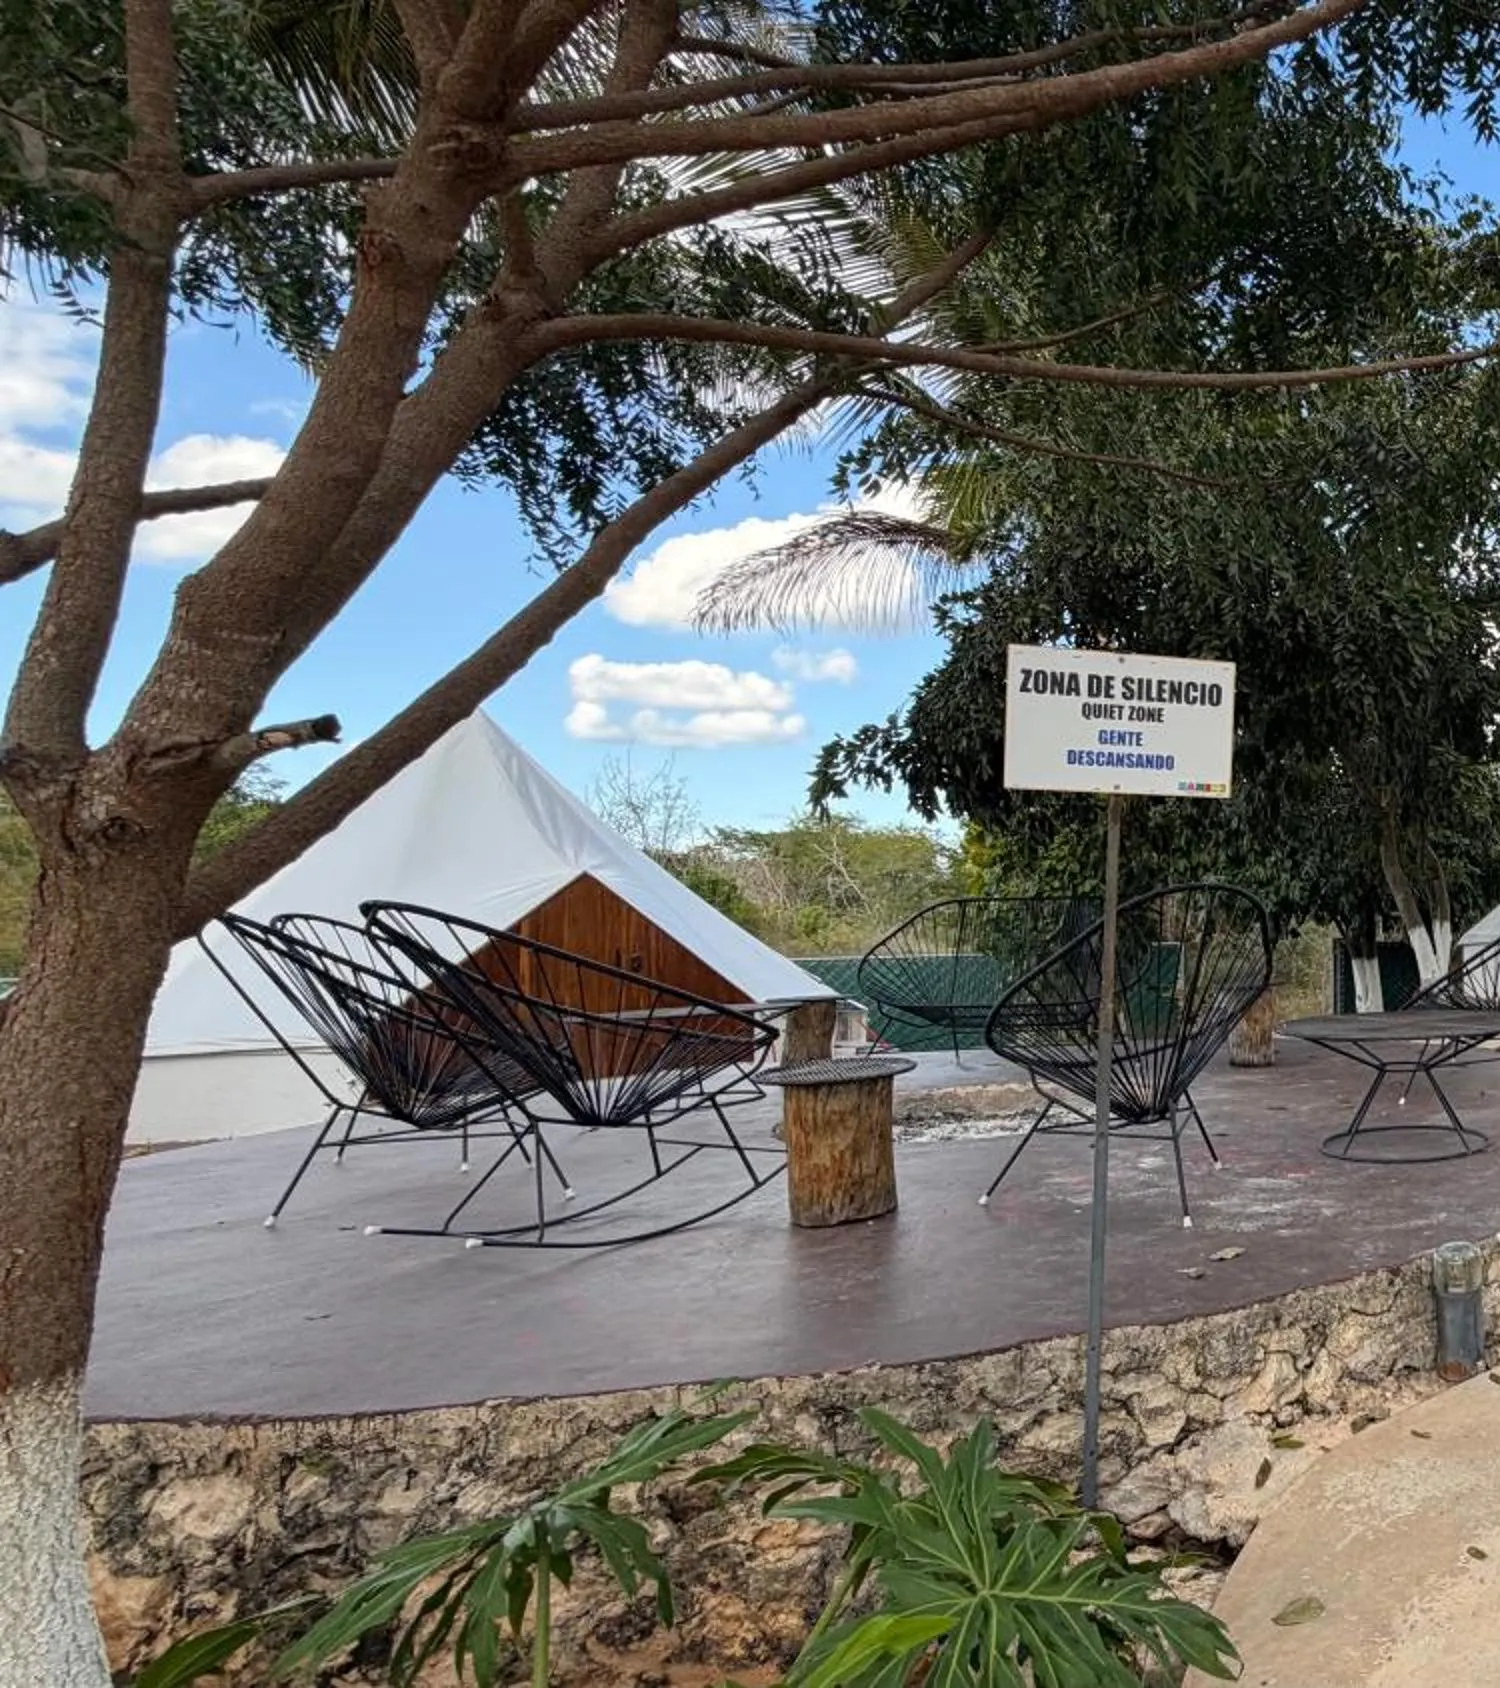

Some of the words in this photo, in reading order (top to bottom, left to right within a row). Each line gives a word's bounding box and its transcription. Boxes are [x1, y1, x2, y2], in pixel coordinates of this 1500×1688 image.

[1019, 668, 1080, 697] ZONA
[1087, 673, 1115, 698] DE
[1121, 676, 1223, 707] SILENCIO
[1081, 702, 1125, 720] QUIET
[1128, 706, 1165, 723] ZONE
[1098, 729, 1143, 747] GENTE
[1067, 749, 1175, 771] DESCANSANDO
